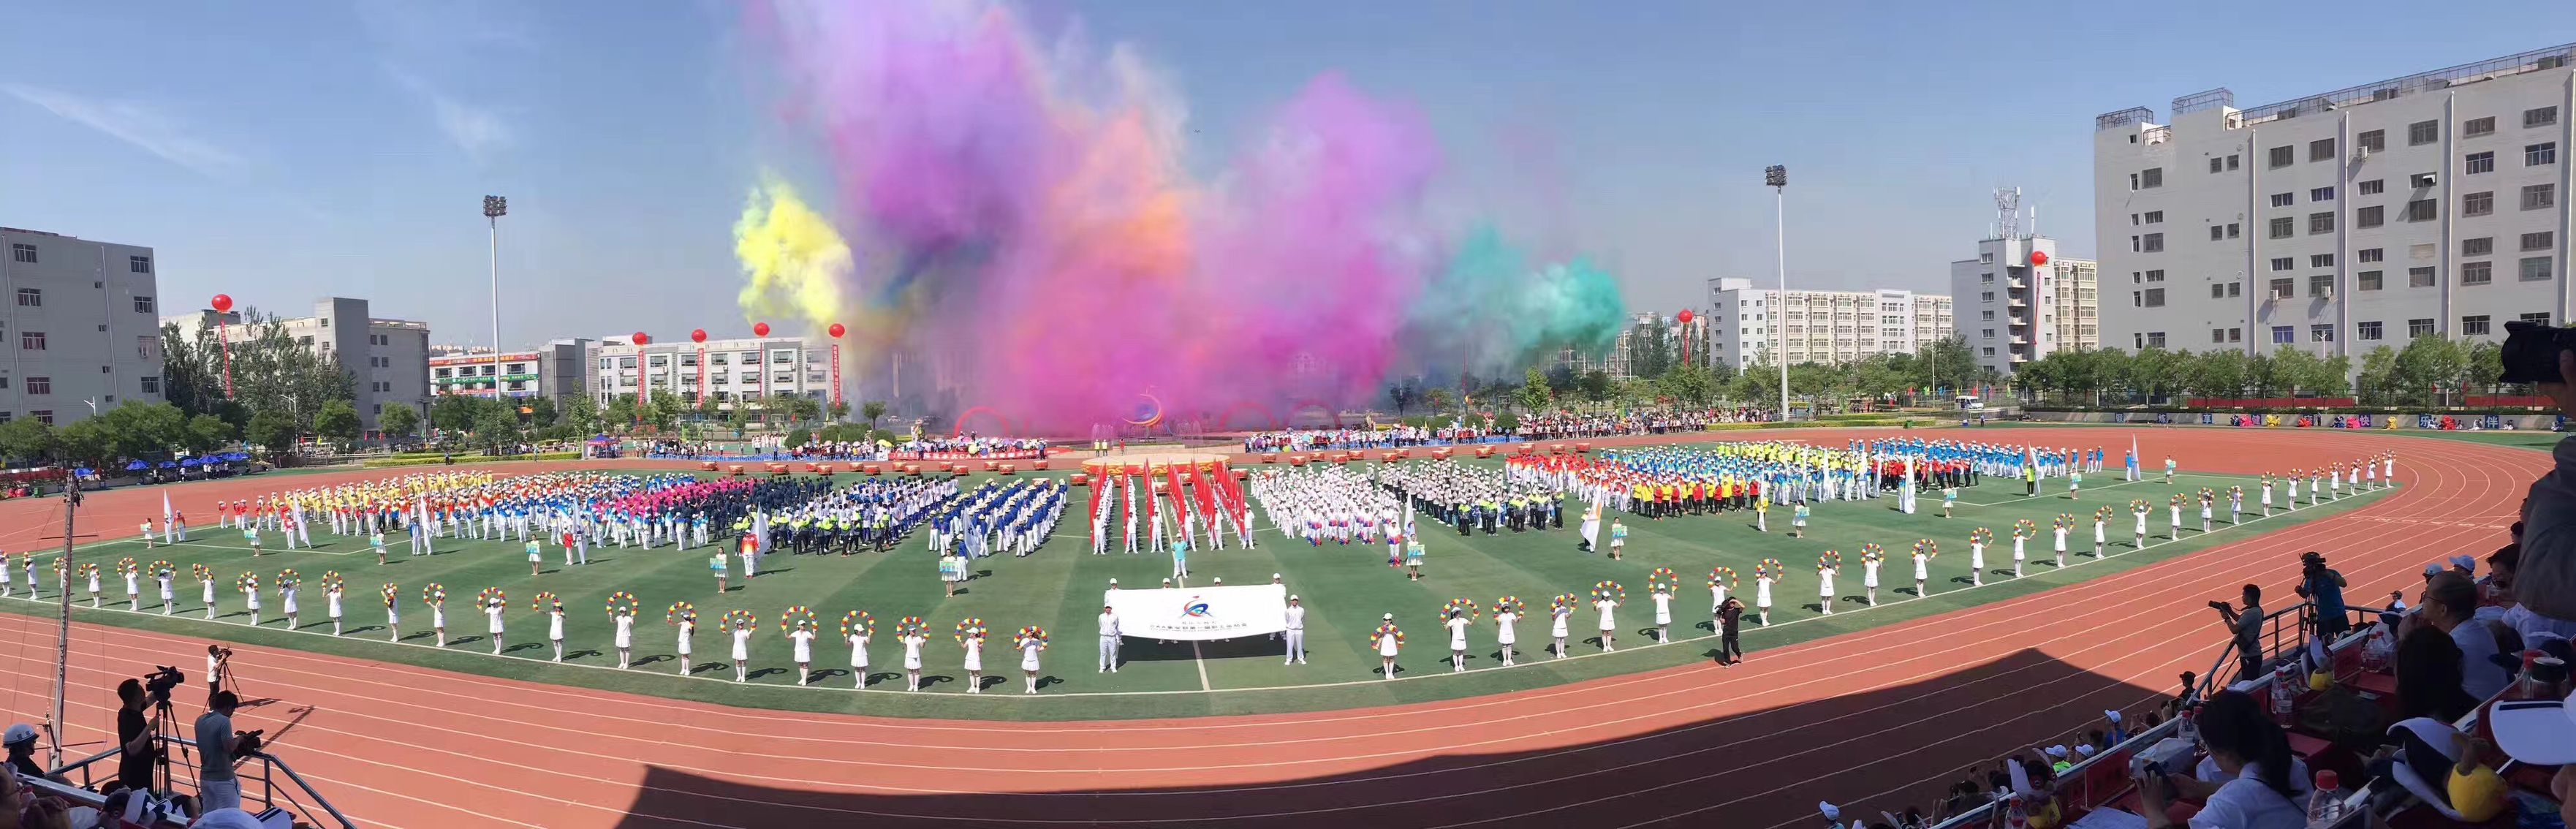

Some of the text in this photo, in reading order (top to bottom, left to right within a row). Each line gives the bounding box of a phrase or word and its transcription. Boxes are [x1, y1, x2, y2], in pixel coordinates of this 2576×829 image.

[2360, 414, 2370, 426] 快
[2420, 415, 2431, 427] 乐
[2486, 415, 2499, 428] 伴
